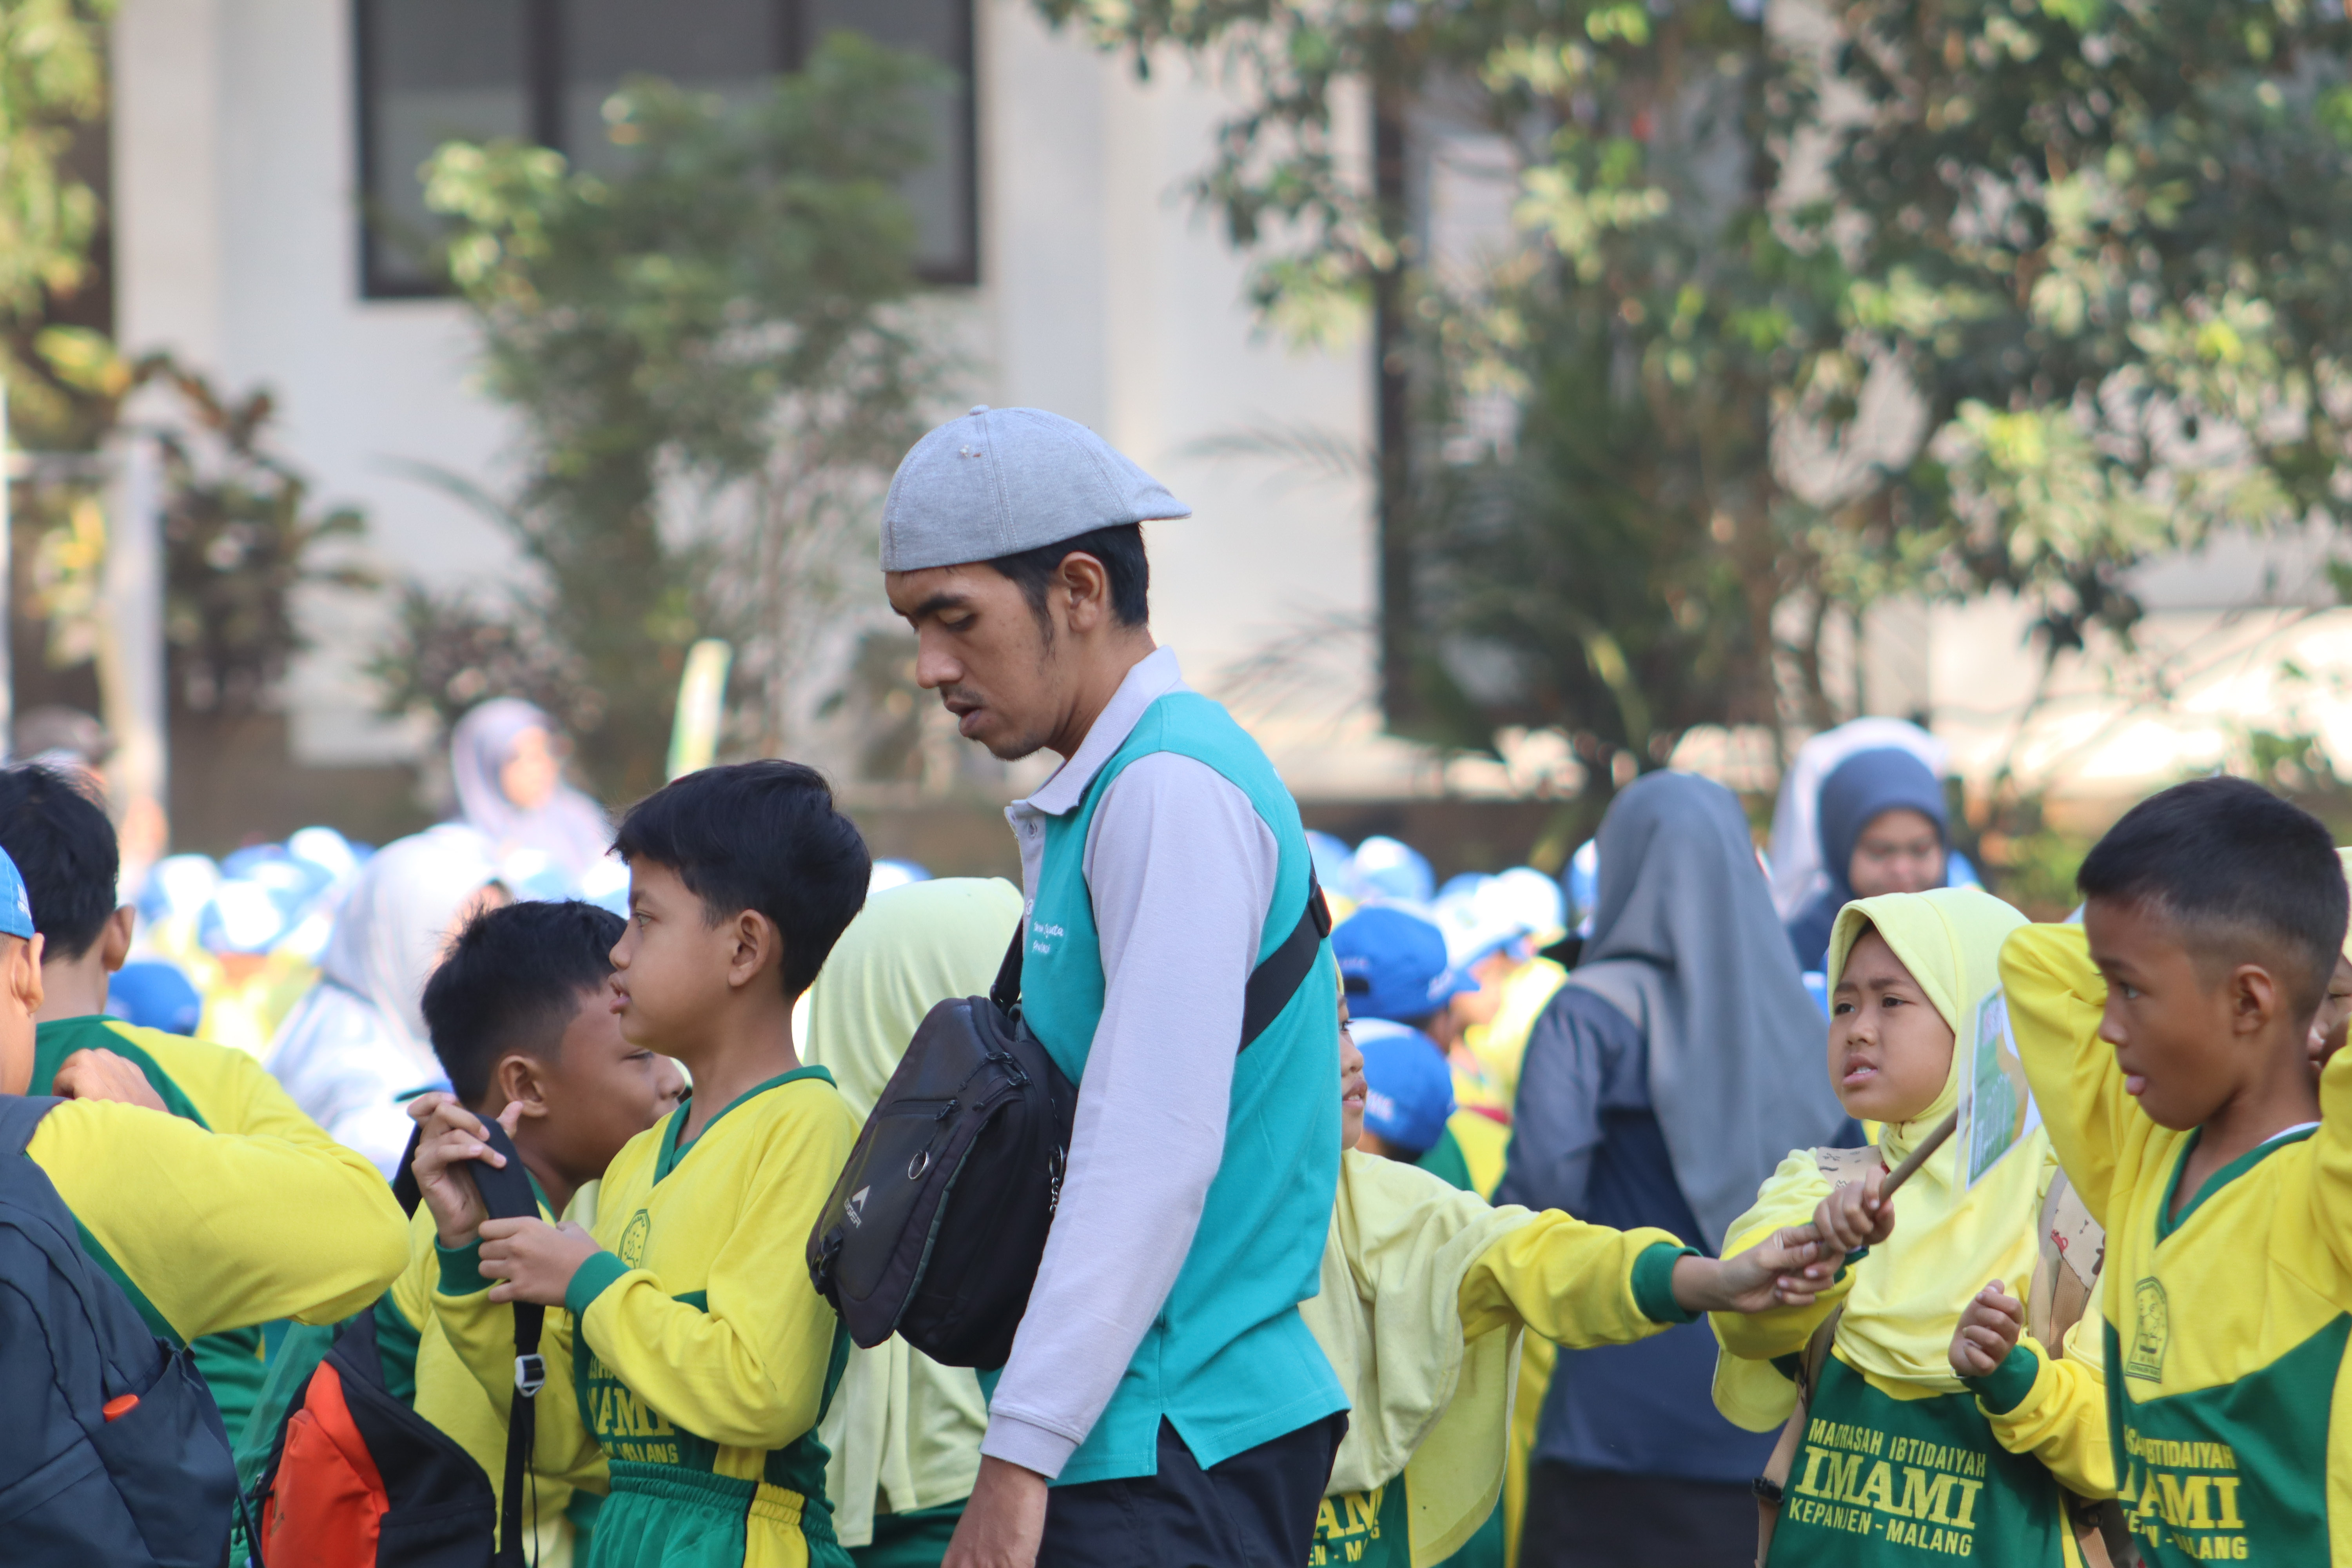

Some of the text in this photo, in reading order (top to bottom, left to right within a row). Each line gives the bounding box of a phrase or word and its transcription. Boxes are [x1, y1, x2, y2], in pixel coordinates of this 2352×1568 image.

[1889, 1436, 1985, 1478] IBTIDAIYAH
[1794, 1445, 1984, 1530] IMAMI
[1789, 1497, 1872, 1535] KEPANJEN
[1886, 1518, 1972, 1556] MALANG
